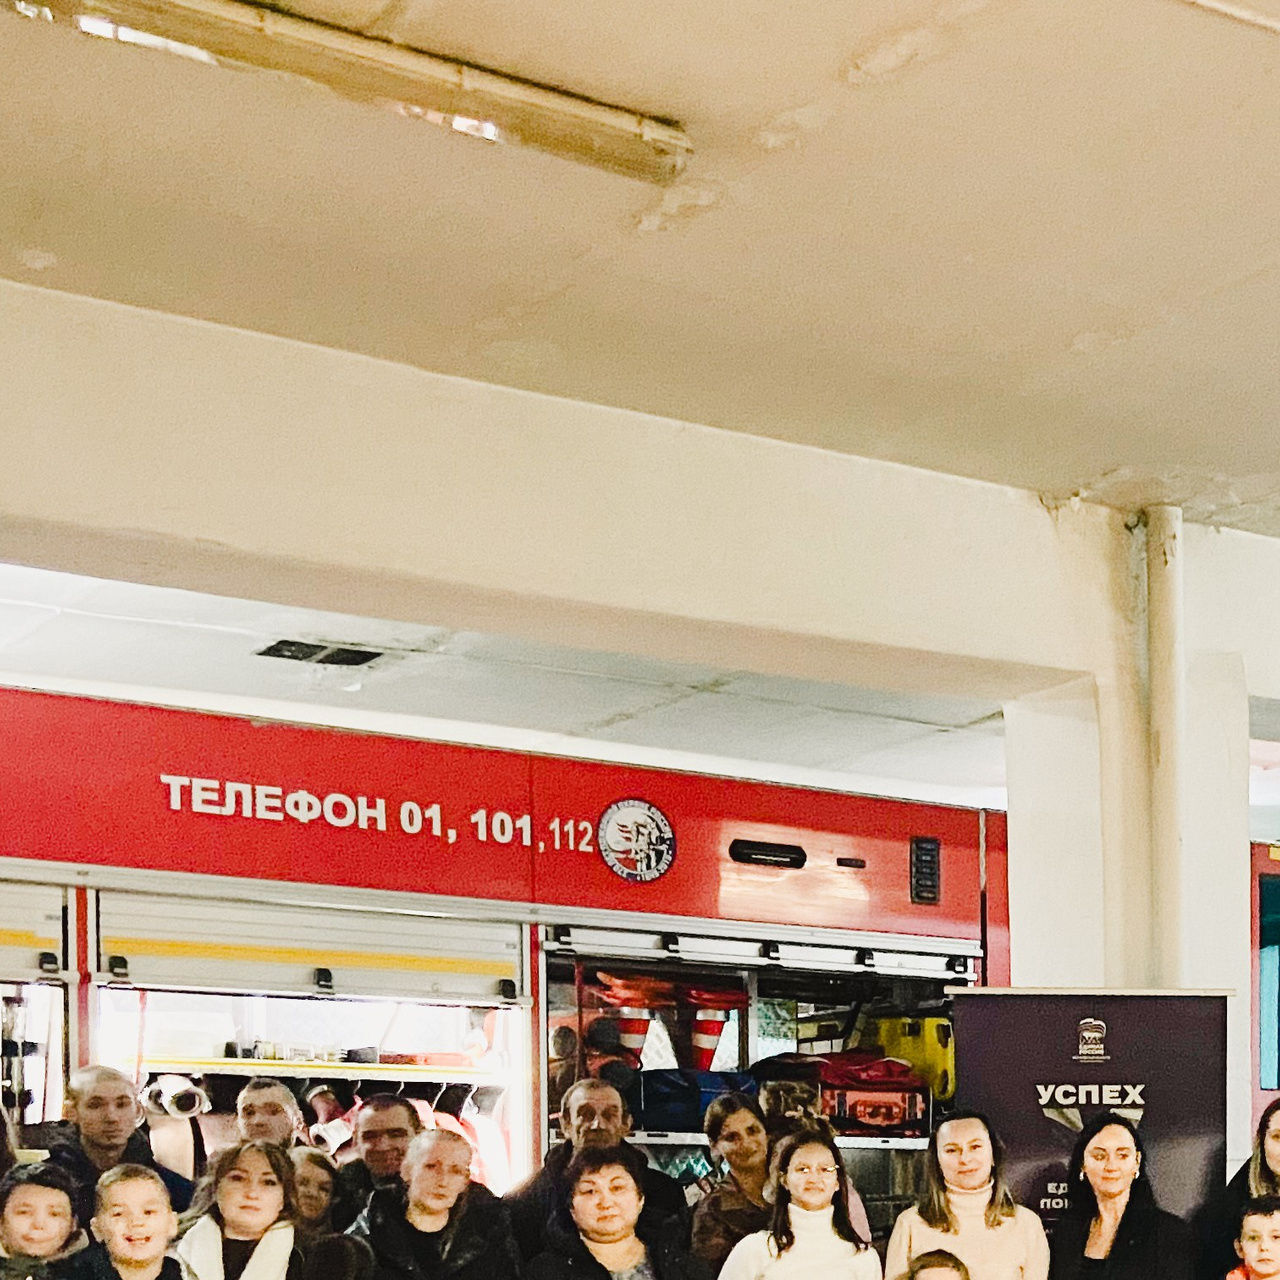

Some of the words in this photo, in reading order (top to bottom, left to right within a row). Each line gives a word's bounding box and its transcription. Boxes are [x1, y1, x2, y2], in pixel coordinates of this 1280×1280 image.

[160, 774, 387, 831] ТЕЛЕФОН
[400, 800, 458, 844] 01,
[1035, 1084, 1146, 1106] УСПЕХ
